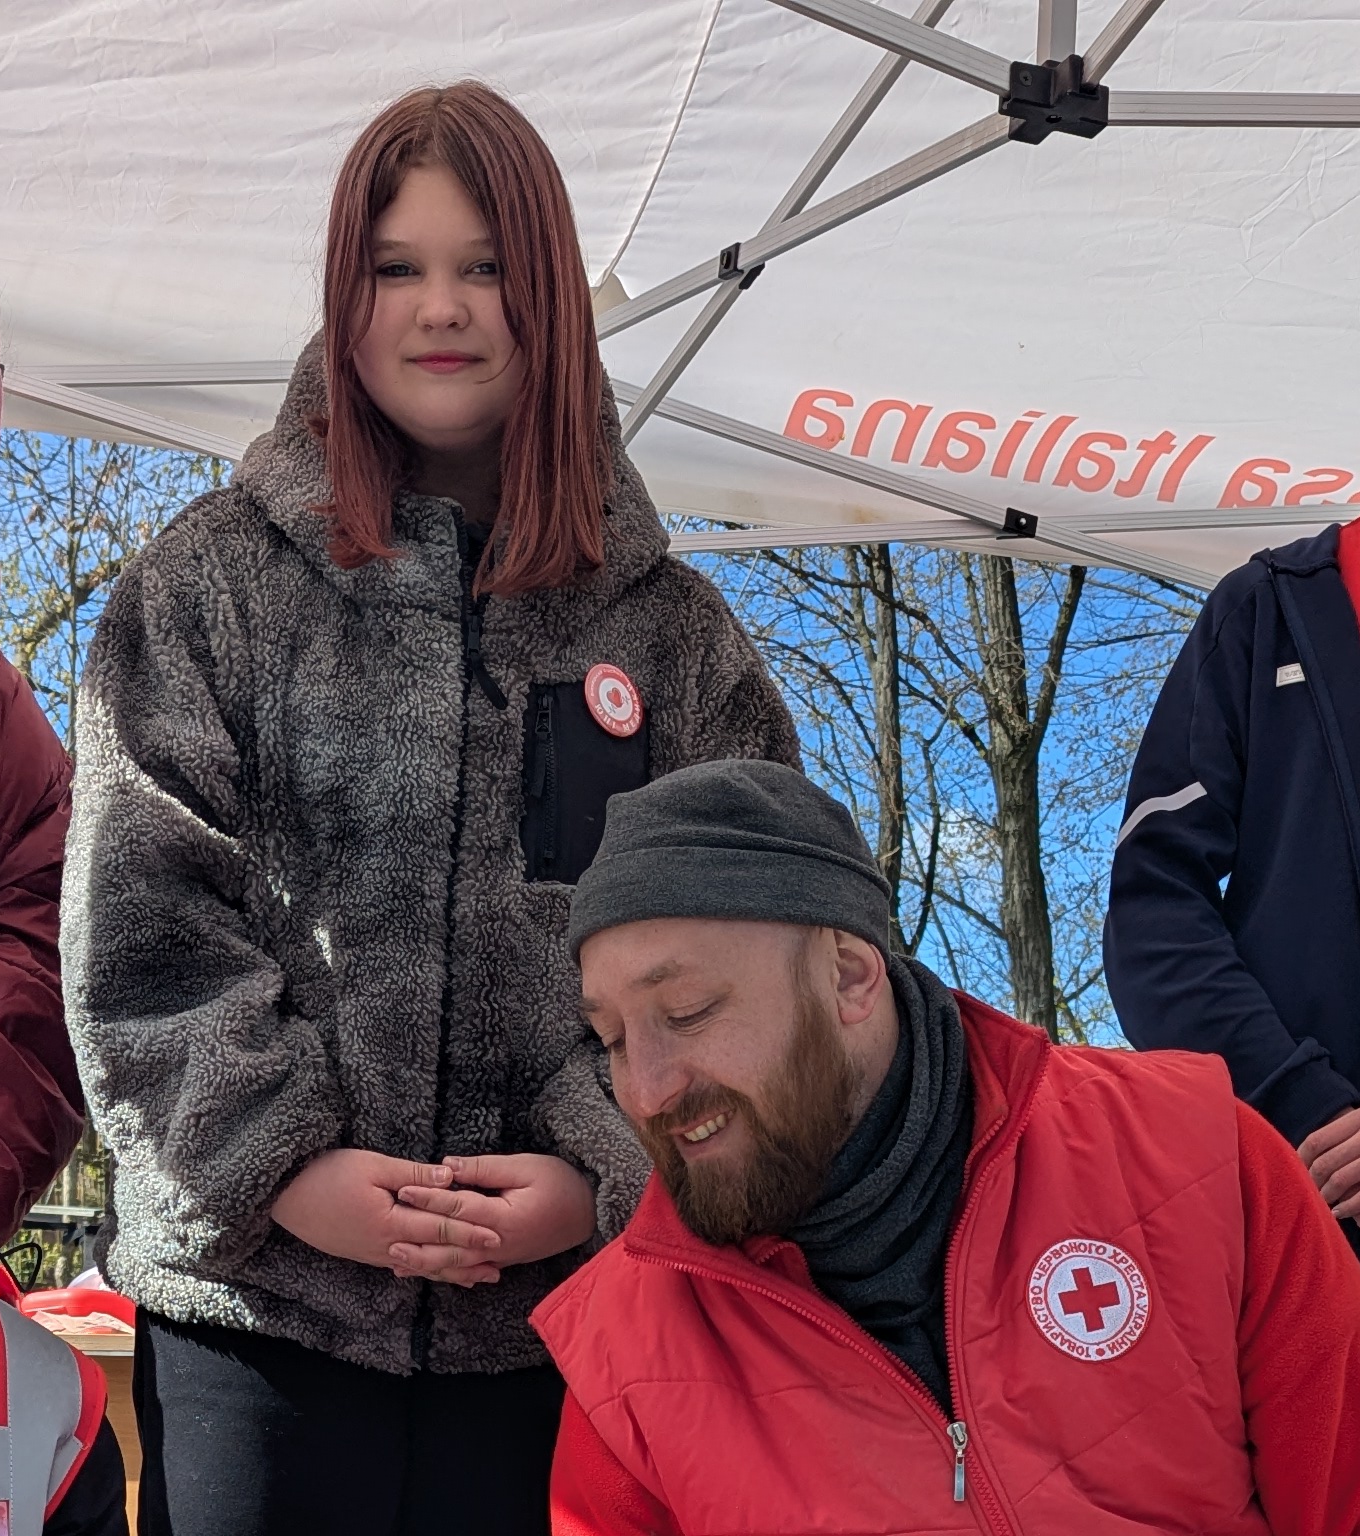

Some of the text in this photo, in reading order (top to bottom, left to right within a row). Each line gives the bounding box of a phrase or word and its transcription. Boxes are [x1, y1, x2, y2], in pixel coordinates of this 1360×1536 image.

[1031, 1242, 1148, 1358] ТОВАРИСТВО ЧЕРВОНОГО ХРЕСТА УКРАЇНИ
